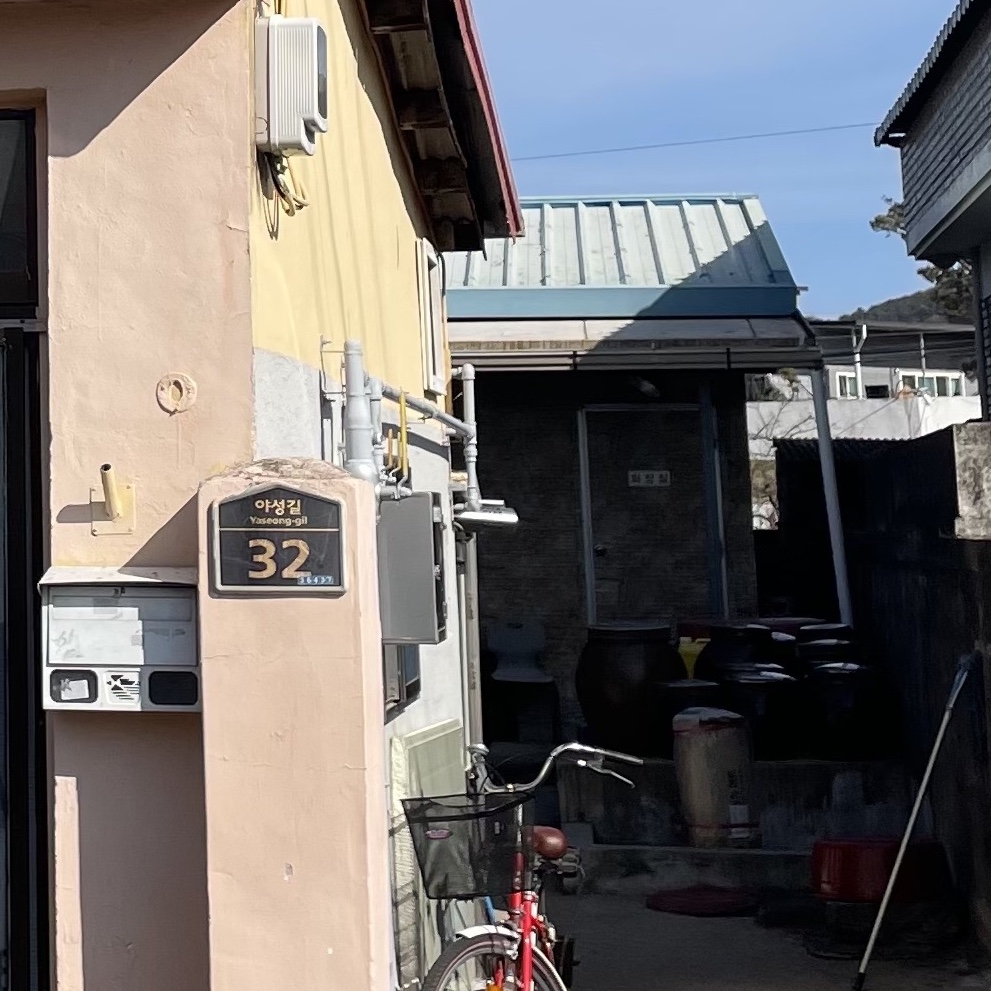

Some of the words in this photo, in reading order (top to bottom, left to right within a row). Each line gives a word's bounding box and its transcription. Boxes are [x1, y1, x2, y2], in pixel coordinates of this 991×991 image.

[254, 499, 302, 516] 야성길
[249, 516, 308, 527] Yaseong-gil
[248, 538, 312, 579] 32
